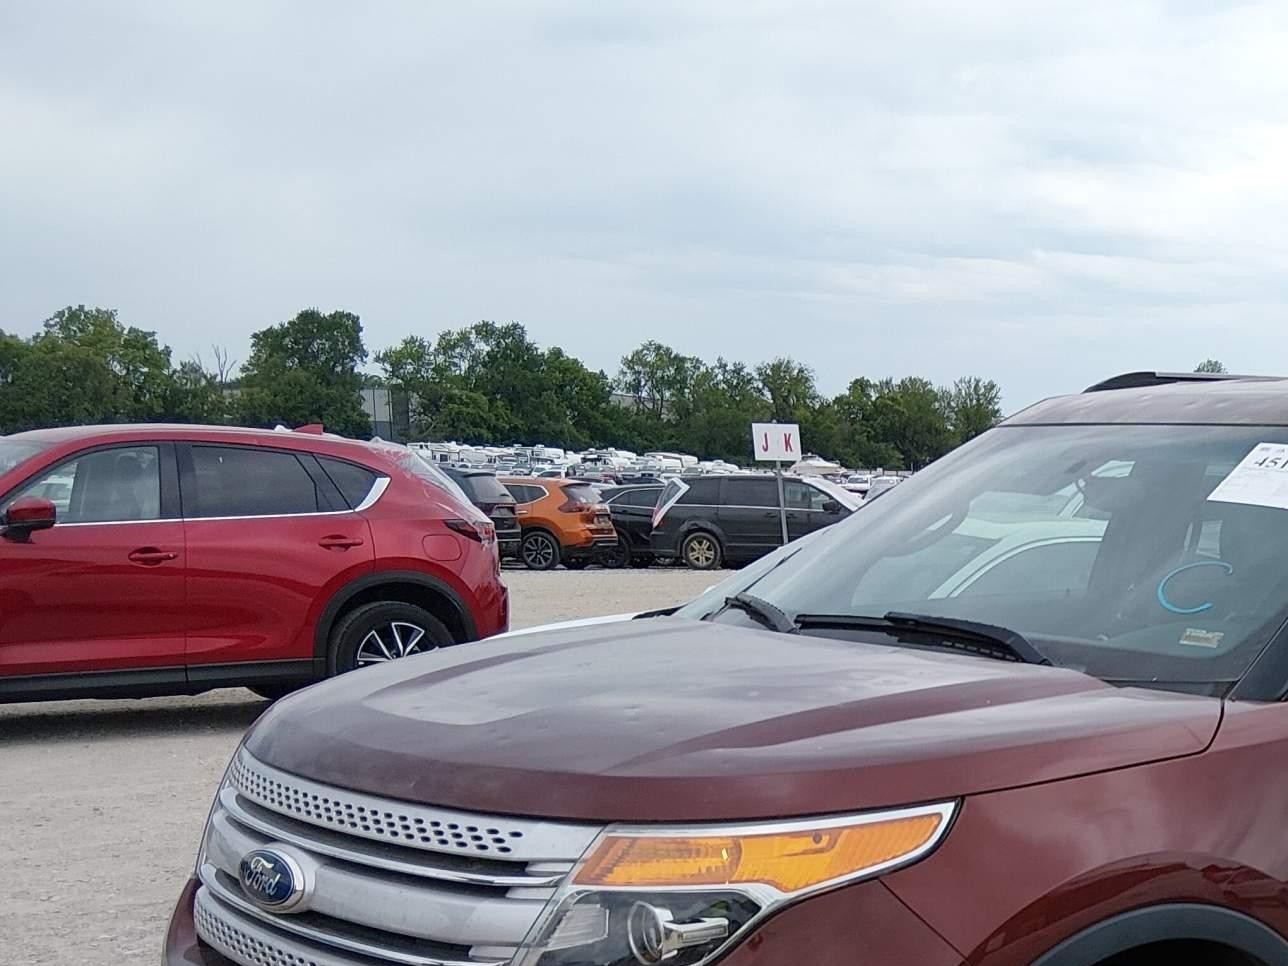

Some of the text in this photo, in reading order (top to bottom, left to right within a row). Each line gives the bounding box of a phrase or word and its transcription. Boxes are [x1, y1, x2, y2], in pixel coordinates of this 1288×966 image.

[762, 432, 793, 452] J K
[1157, 560, 1233, 614] C
[245, 856, 281, 896] Ford
